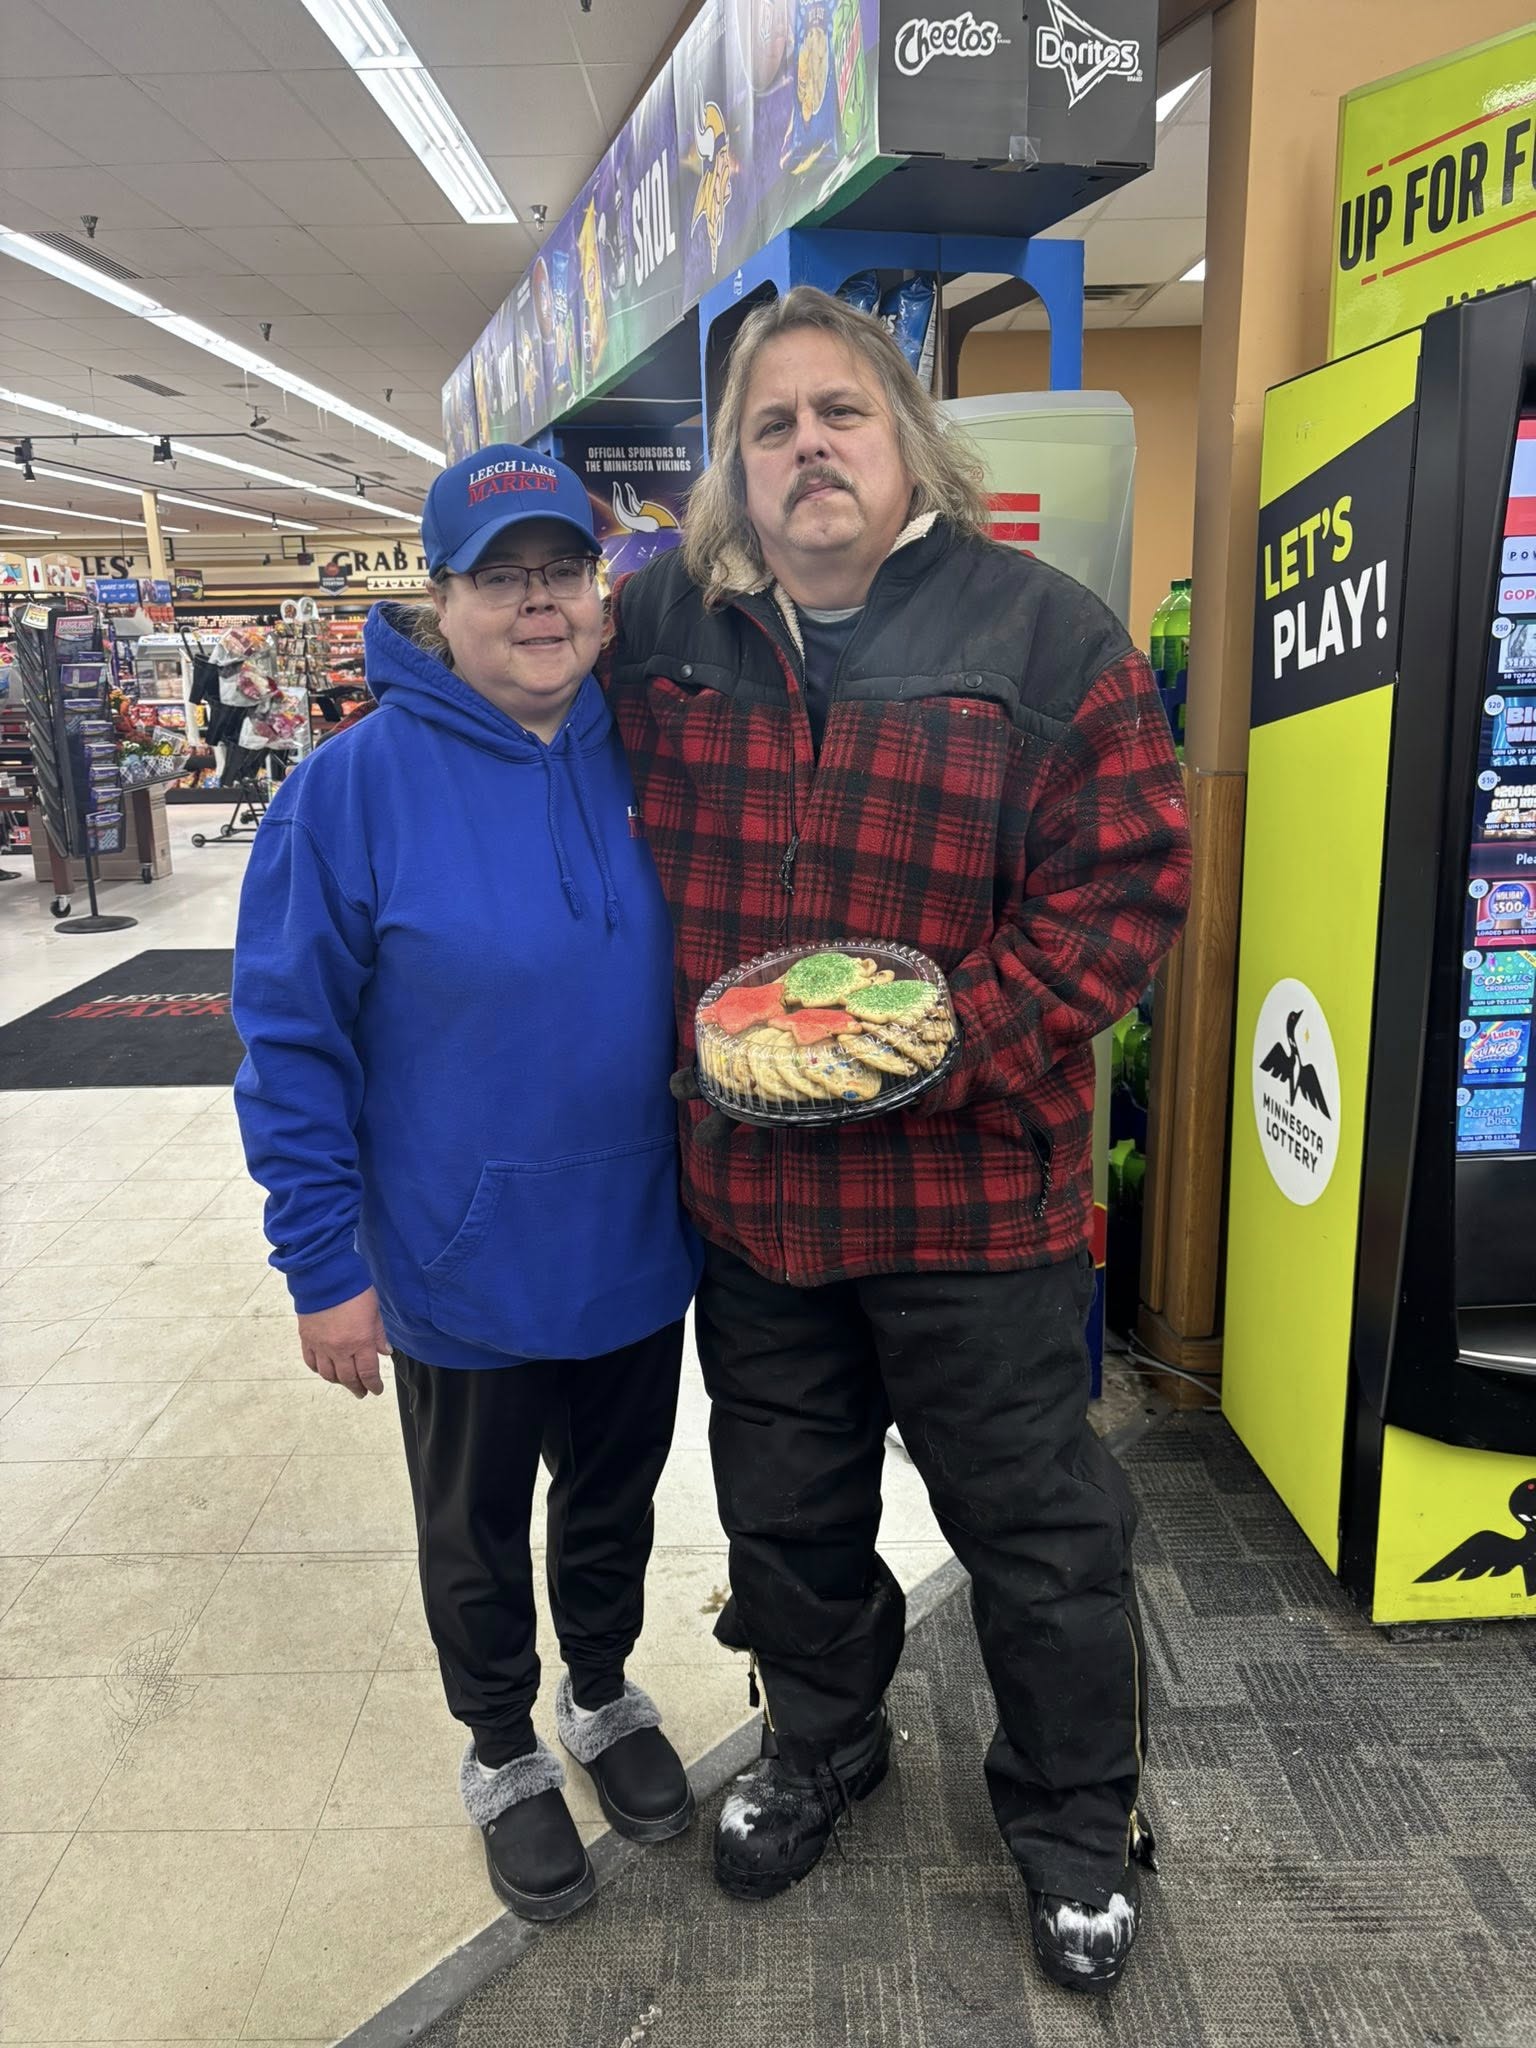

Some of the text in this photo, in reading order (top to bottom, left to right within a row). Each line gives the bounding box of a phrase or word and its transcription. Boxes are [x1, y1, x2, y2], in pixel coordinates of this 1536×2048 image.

[895, 11, 998, 76] Cheetos
[1039, 28, 1137, 71] Doritos
[1340, 118, 1536, 271] UP FOR F
[632, 147, 676, 288] SKOL
[585, 460, 692, 472] THE MINNESOTA VIKINGS
[588, 447, 687, 459] OFFICIAL SPONSORS OF
[469, 461, 557, 486] LEECH LAKE
[468, 474, 558, 507] MARKET
[1264, 495, 1353, 601] LET'S
[1504, 589, 1536, 602] GOP
[1273, 560, 1387, 680] PLAY!
[1506, 706, 1536, 724] BI
[1491, 798, 1519, 810] GOLD
[49, 1003, 231, 1019] MARK
[88, 992, 230, 1004] LEECH
[1263, 1092, 1324, 1155] MINNESOTA
[1266, 1116, 1318, 1174] LOTTERY
